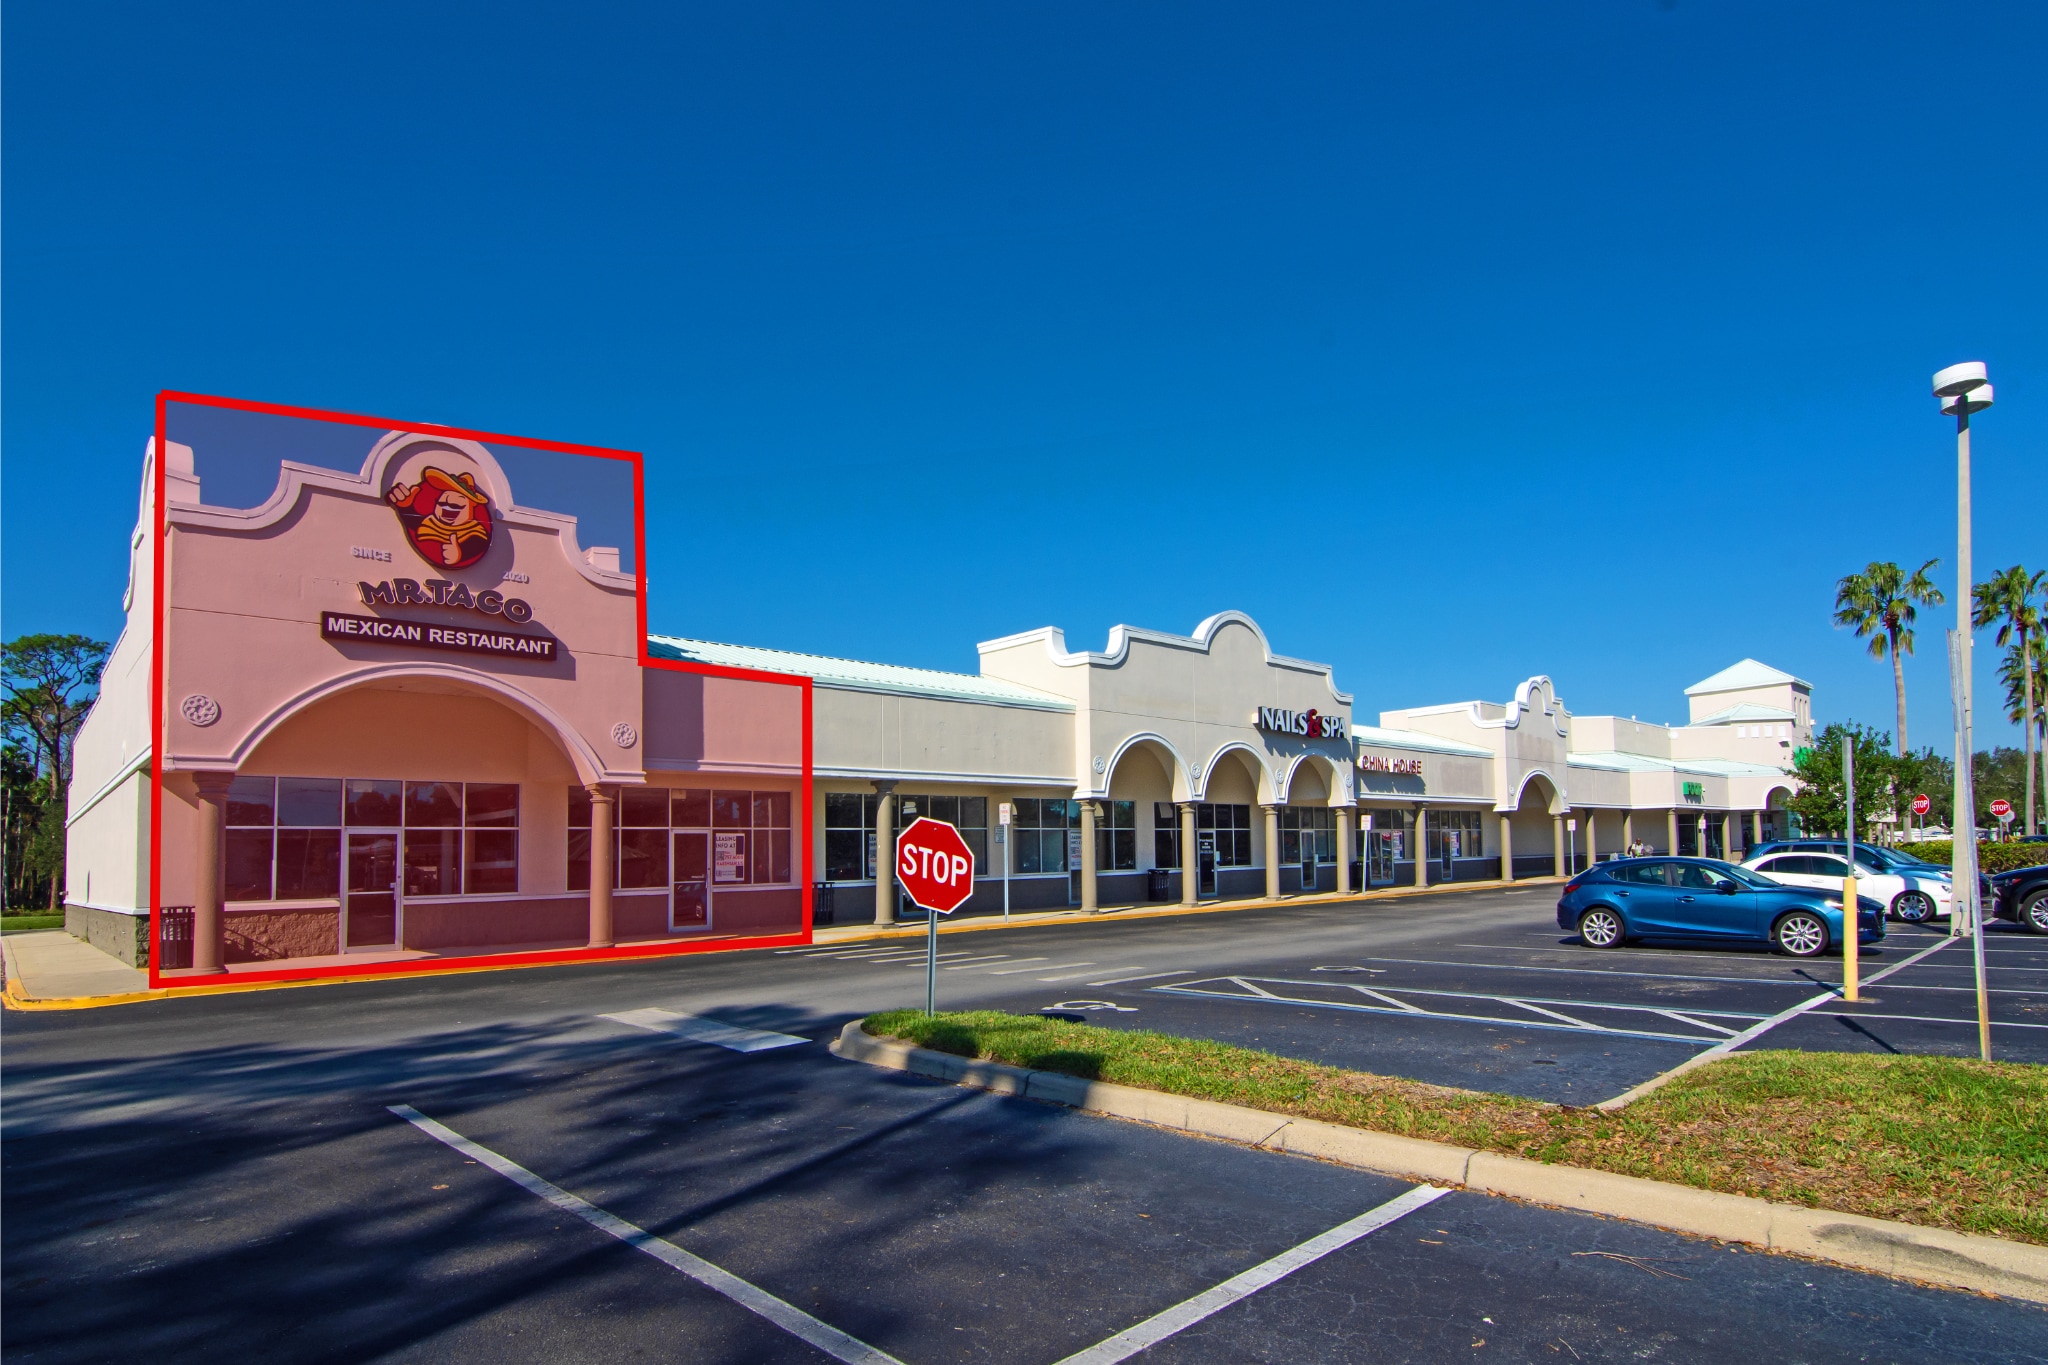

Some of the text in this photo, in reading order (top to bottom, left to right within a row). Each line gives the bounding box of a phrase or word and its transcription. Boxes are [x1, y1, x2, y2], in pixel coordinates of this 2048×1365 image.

[352, 546, 392, 562] SINCE
[502, 571, 529, 583] 2020
[328, 618, 551, 655] MEXICAN RESTAURANT
[1259, 706, 1308, 736] NAILS
[1320, 716, 1347, 739] SPA
[1361, 755, 1422, 774] CHINA HOUSE
[1913, 800, 1928, 809] STOP
[1991, 804, 2009, 812] STOP
[902, 843, 968, 887] STOP
